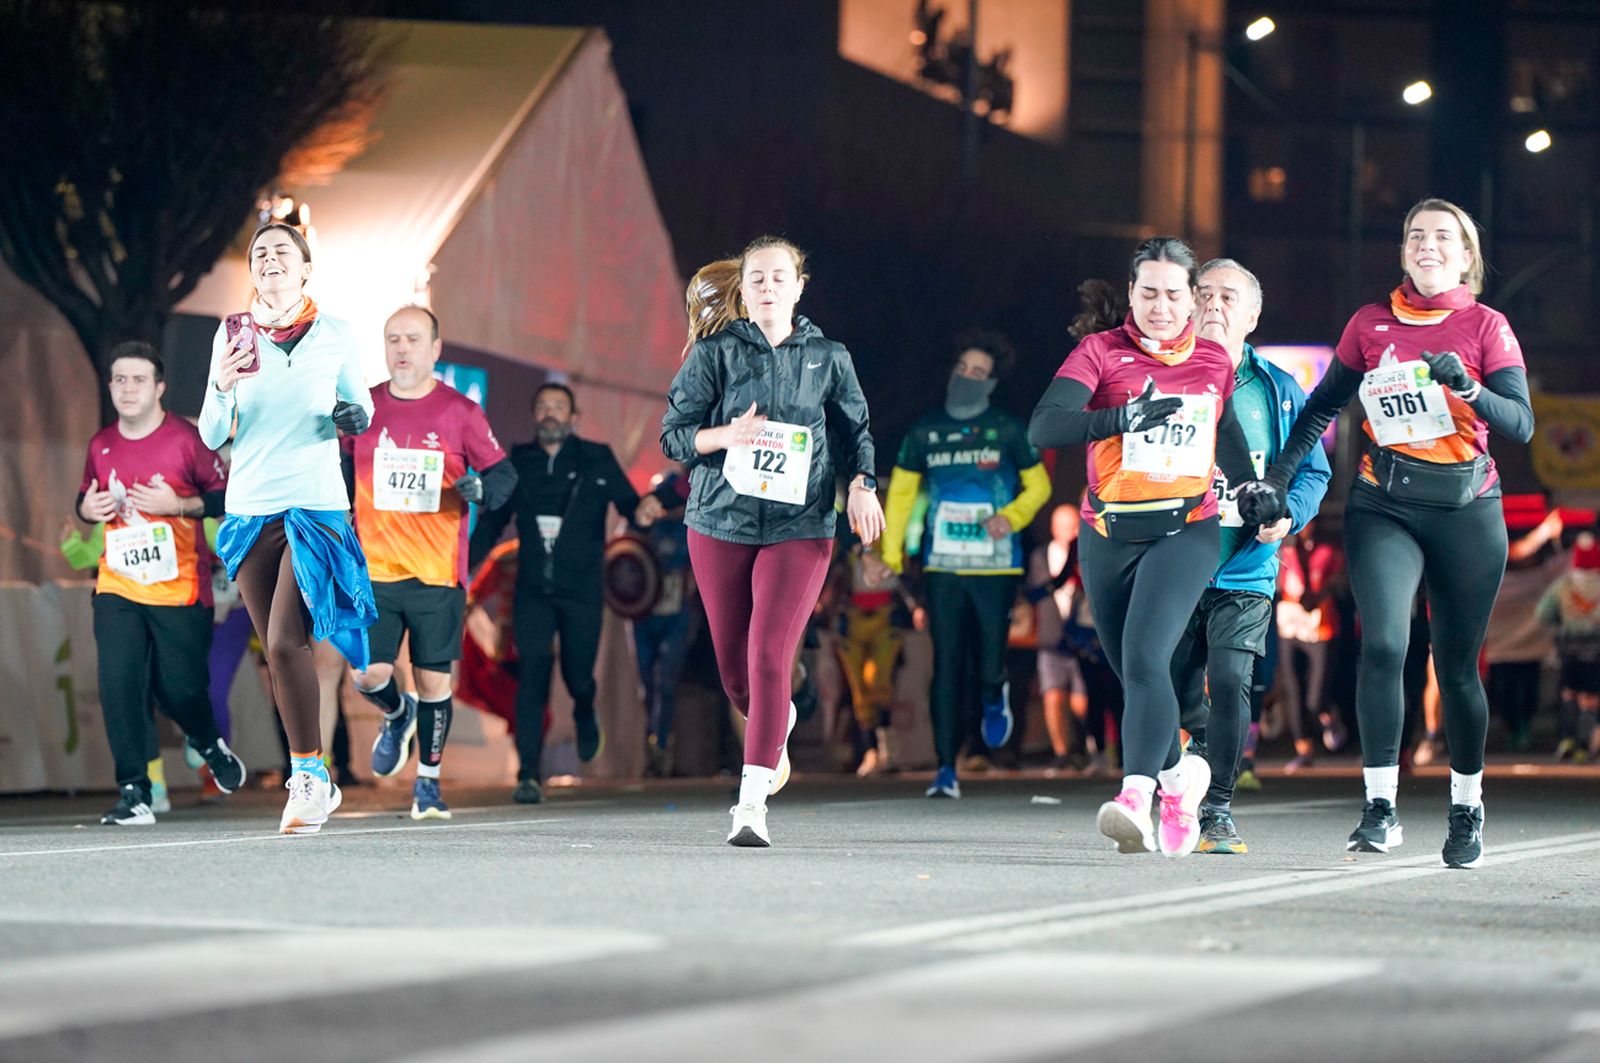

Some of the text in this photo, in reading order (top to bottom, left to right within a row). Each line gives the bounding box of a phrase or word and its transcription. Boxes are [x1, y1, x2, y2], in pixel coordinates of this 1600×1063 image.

[1367, 386, 1383, 397] SAN
[1379, 391, 1428, 418] 5761
[752, 448, 788, 475] 122
[926, 446, 1000, 468] SAN ANTÓN
[388, 471, 427, 491] 4724
[122, 545, 162, 567] 1344
